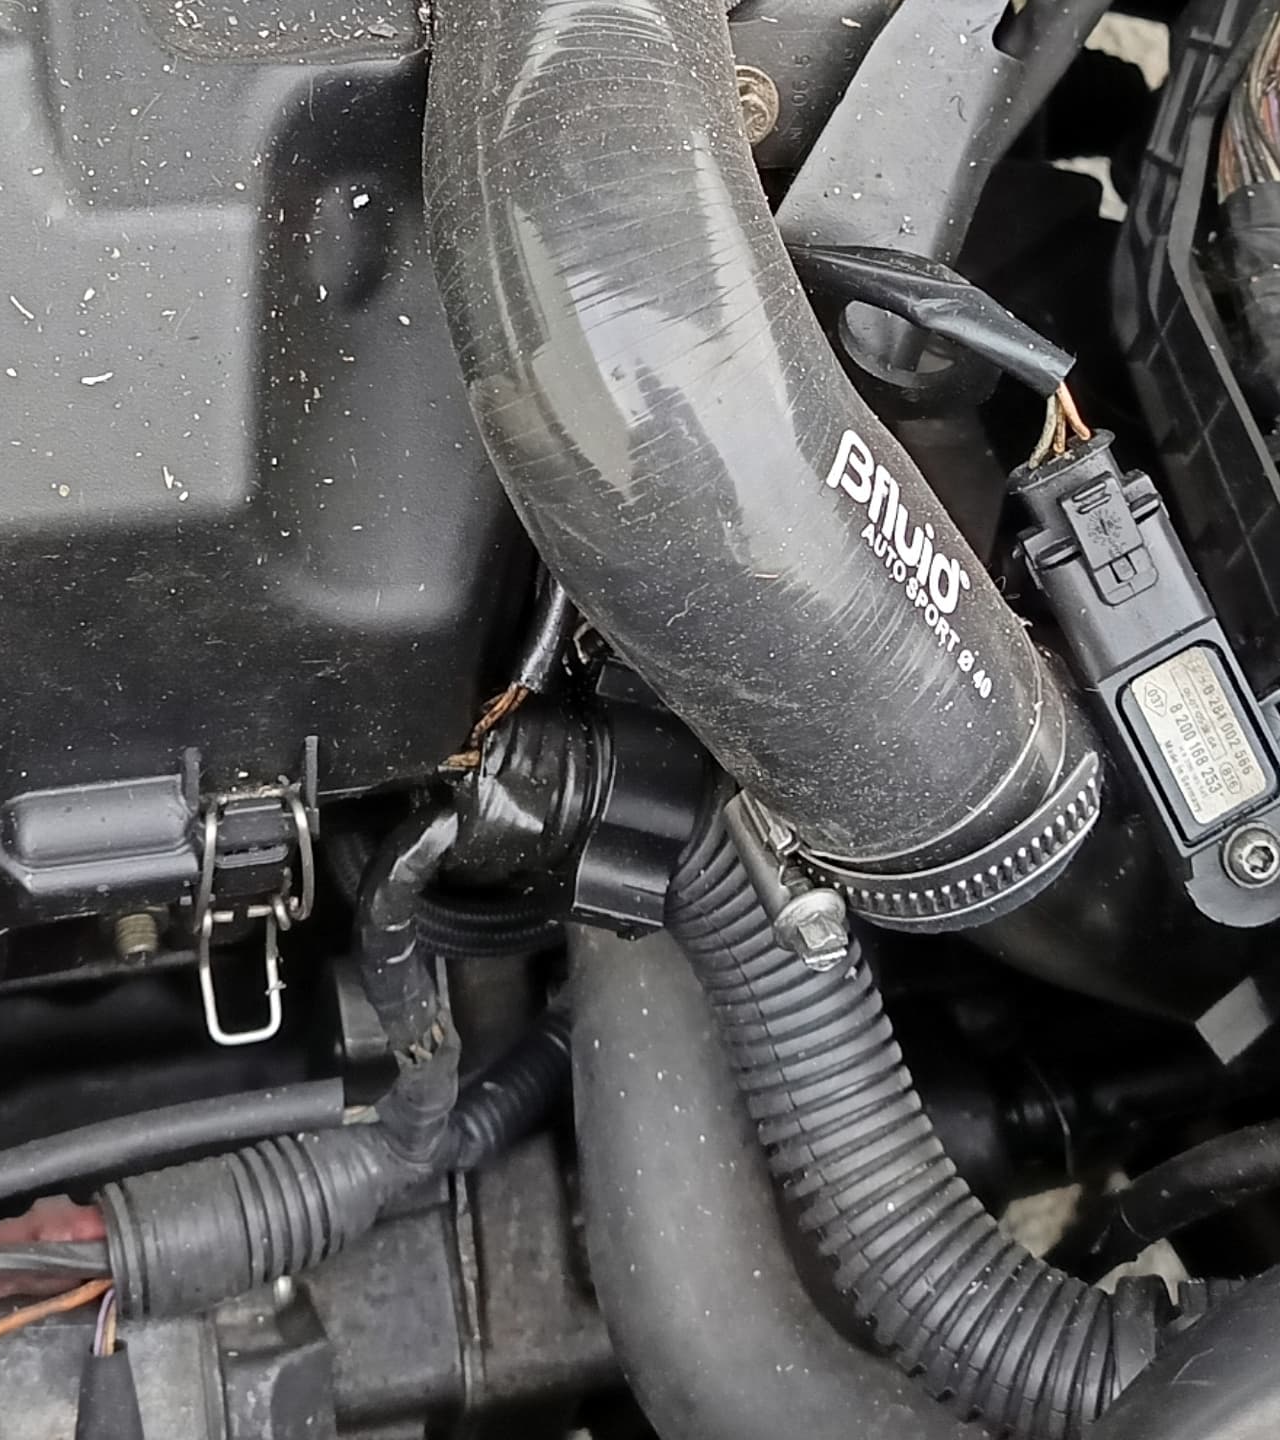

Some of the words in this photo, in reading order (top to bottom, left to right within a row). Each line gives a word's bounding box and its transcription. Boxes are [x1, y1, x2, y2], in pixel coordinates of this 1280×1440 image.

[861, 523, 907, 583] AUTO
[905, 579, 961, 652] SPORT
[972, 669, 993, 698] 40
[1147, 689, 1165, 709] 037
[1169, 704, 1183, 714] 8
[1175, 715, 1198, 741] 200
[1221, 722, 1242, 746] 002
[1188, 743, 1209, 766] 168
